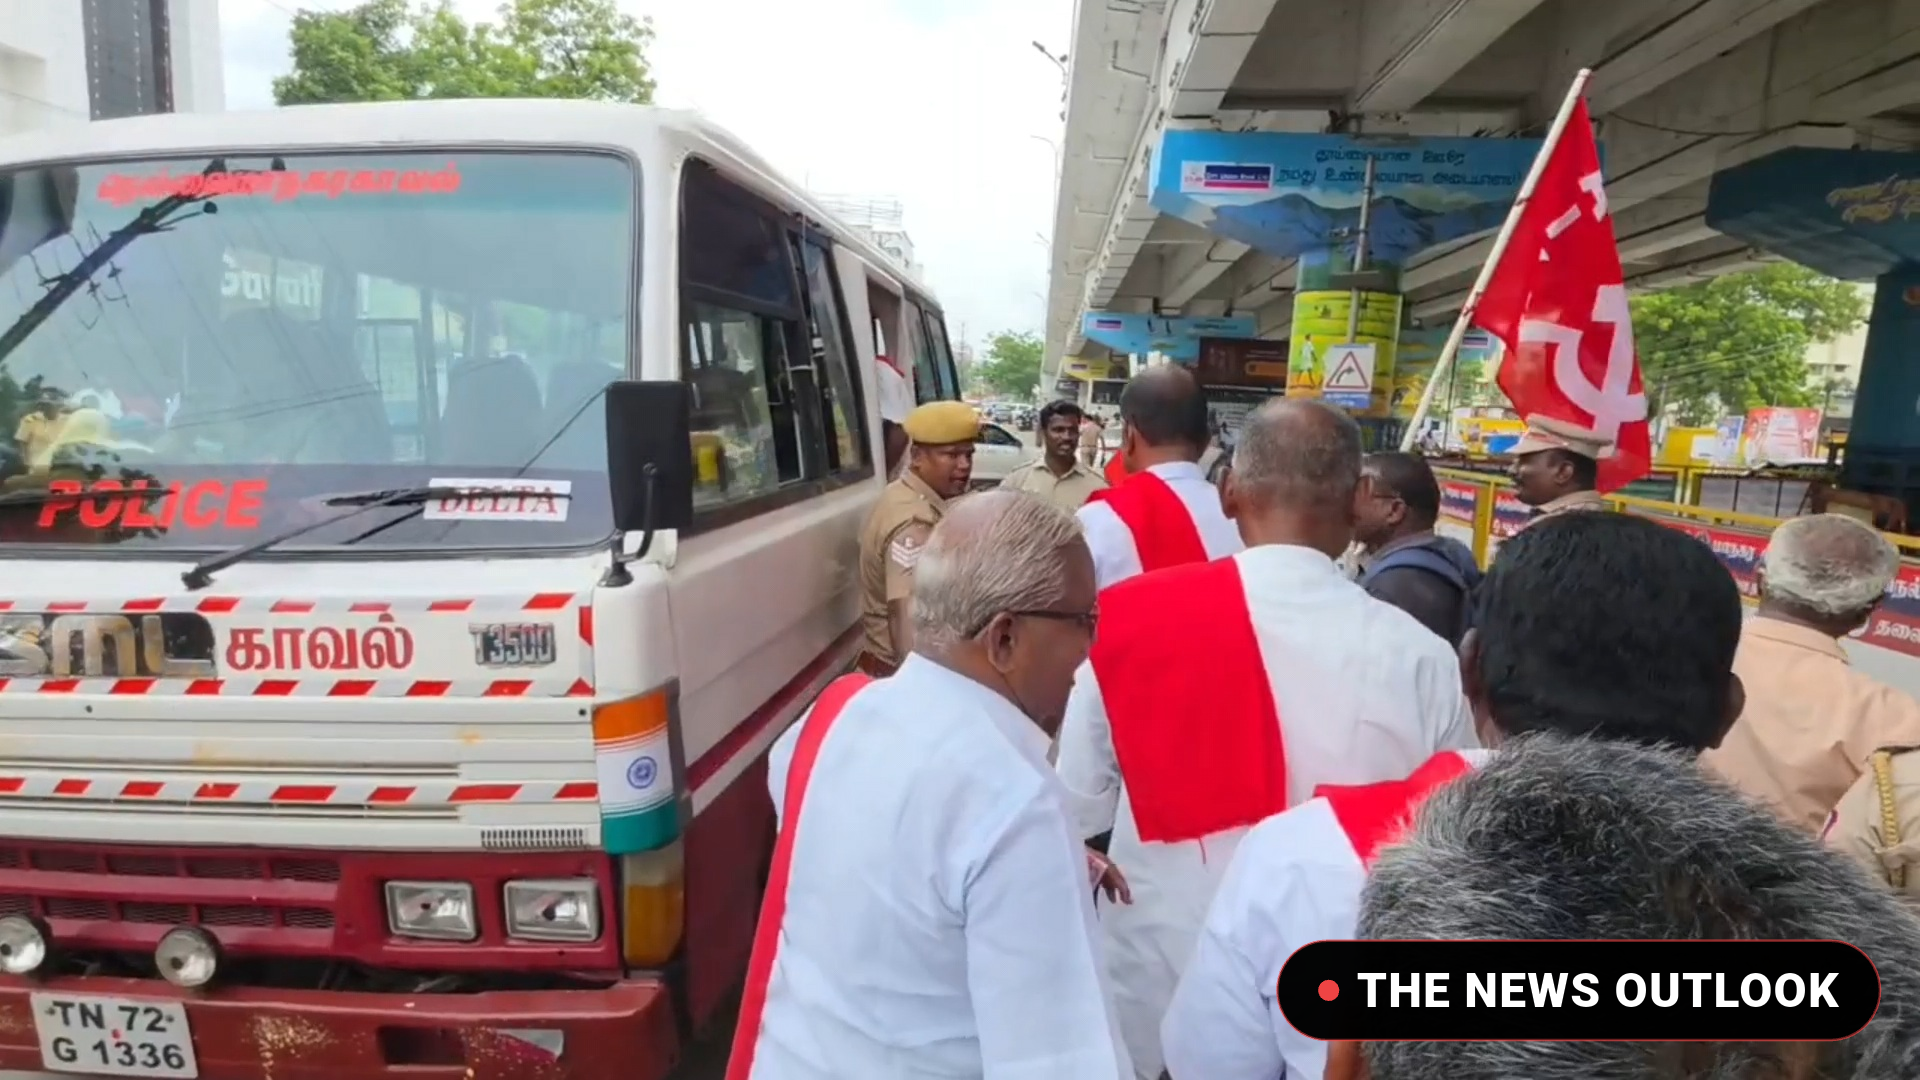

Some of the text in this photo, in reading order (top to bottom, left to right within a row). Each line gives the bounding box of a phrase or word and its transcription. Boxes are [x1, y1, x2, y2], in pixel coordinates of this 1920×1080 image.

[38, 479, 268, 529] POLICE
[438, 486, 557, 514] DELTA
[226, 613, 414, 671] காவல்
[468, 622, 557, 667] T3500
[52, 1001, 167, 1032] TN 72
[52, 1036, 186, 1070] G 1336
